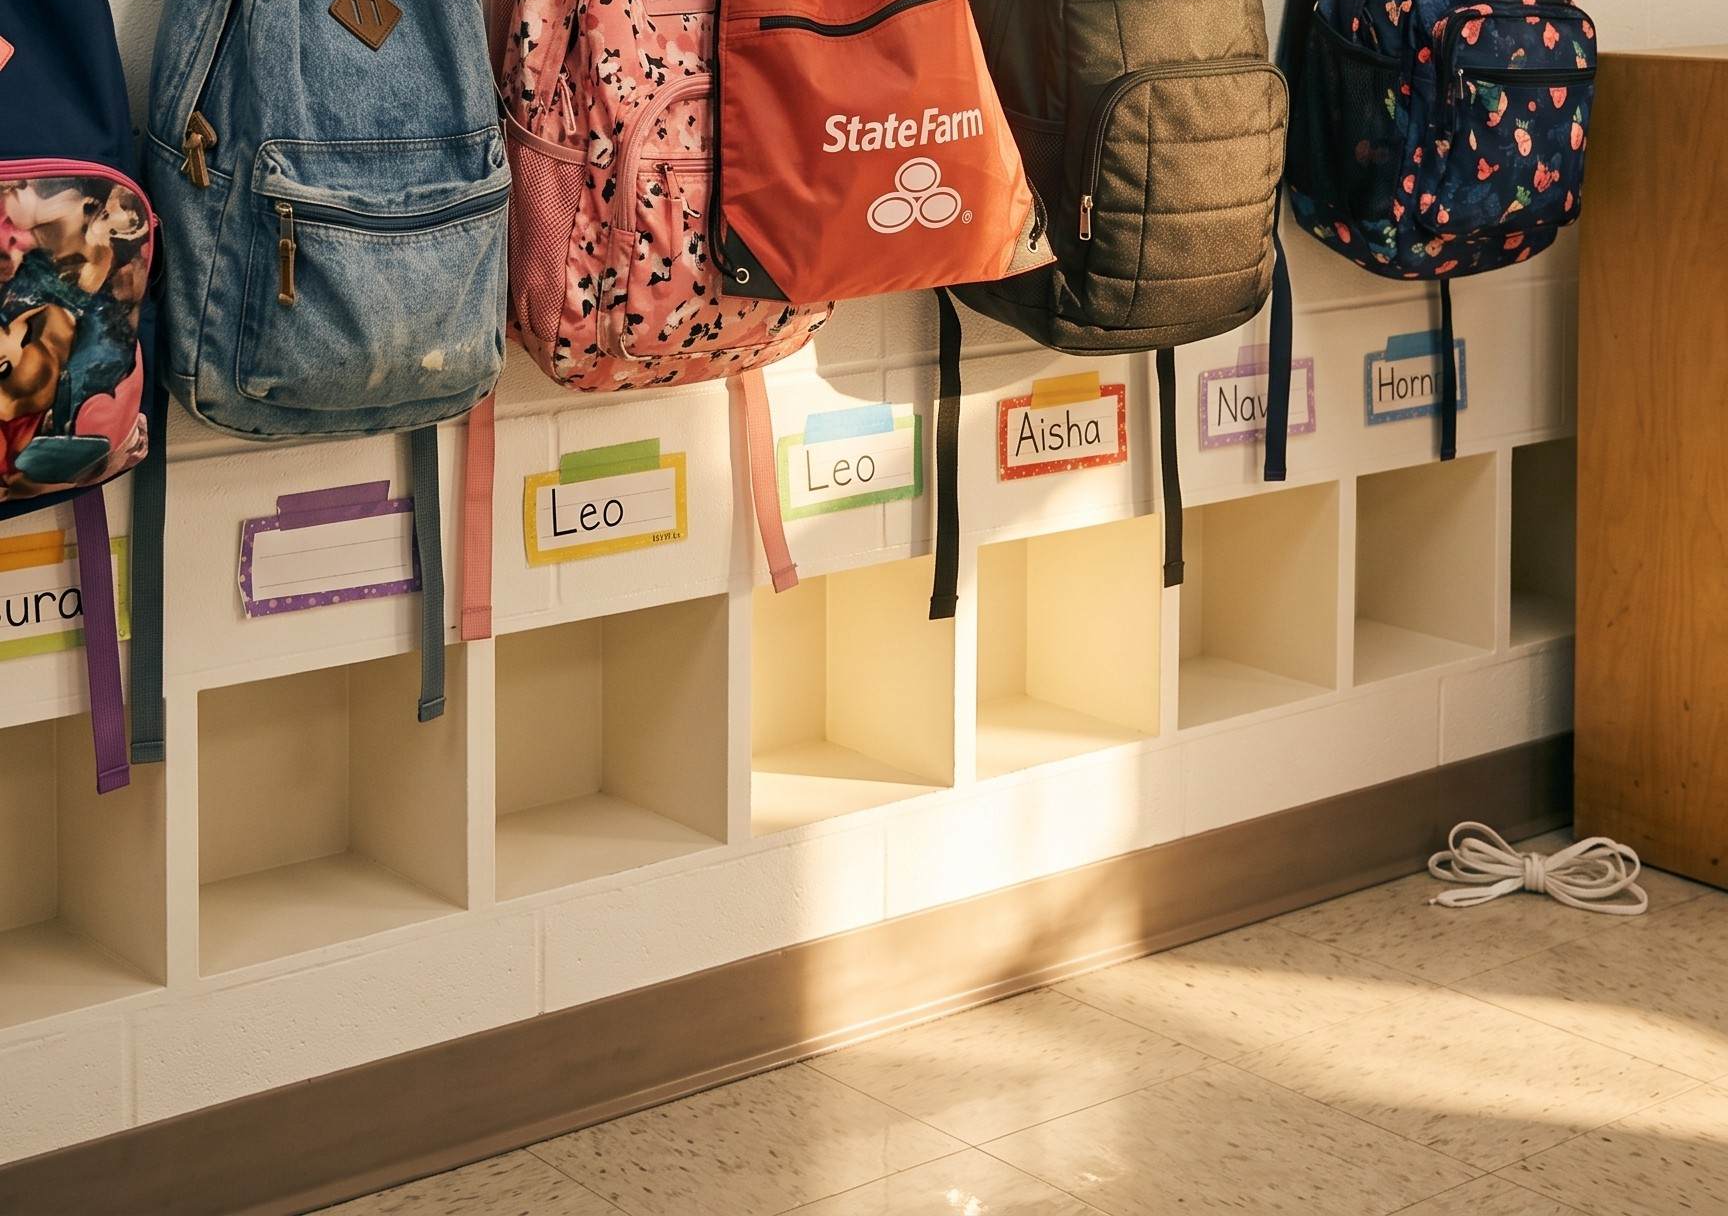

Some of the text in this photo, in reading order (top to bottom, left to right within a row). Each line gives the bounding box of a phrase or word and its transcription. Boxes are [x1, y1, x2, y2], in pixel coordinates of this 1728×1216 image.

[1015, 409, 1101, 457] Aisha
[806, 449, 875, 491] Leo
[551, 488, 624, 536] Leo
[0, 587, 83, 627] ura
